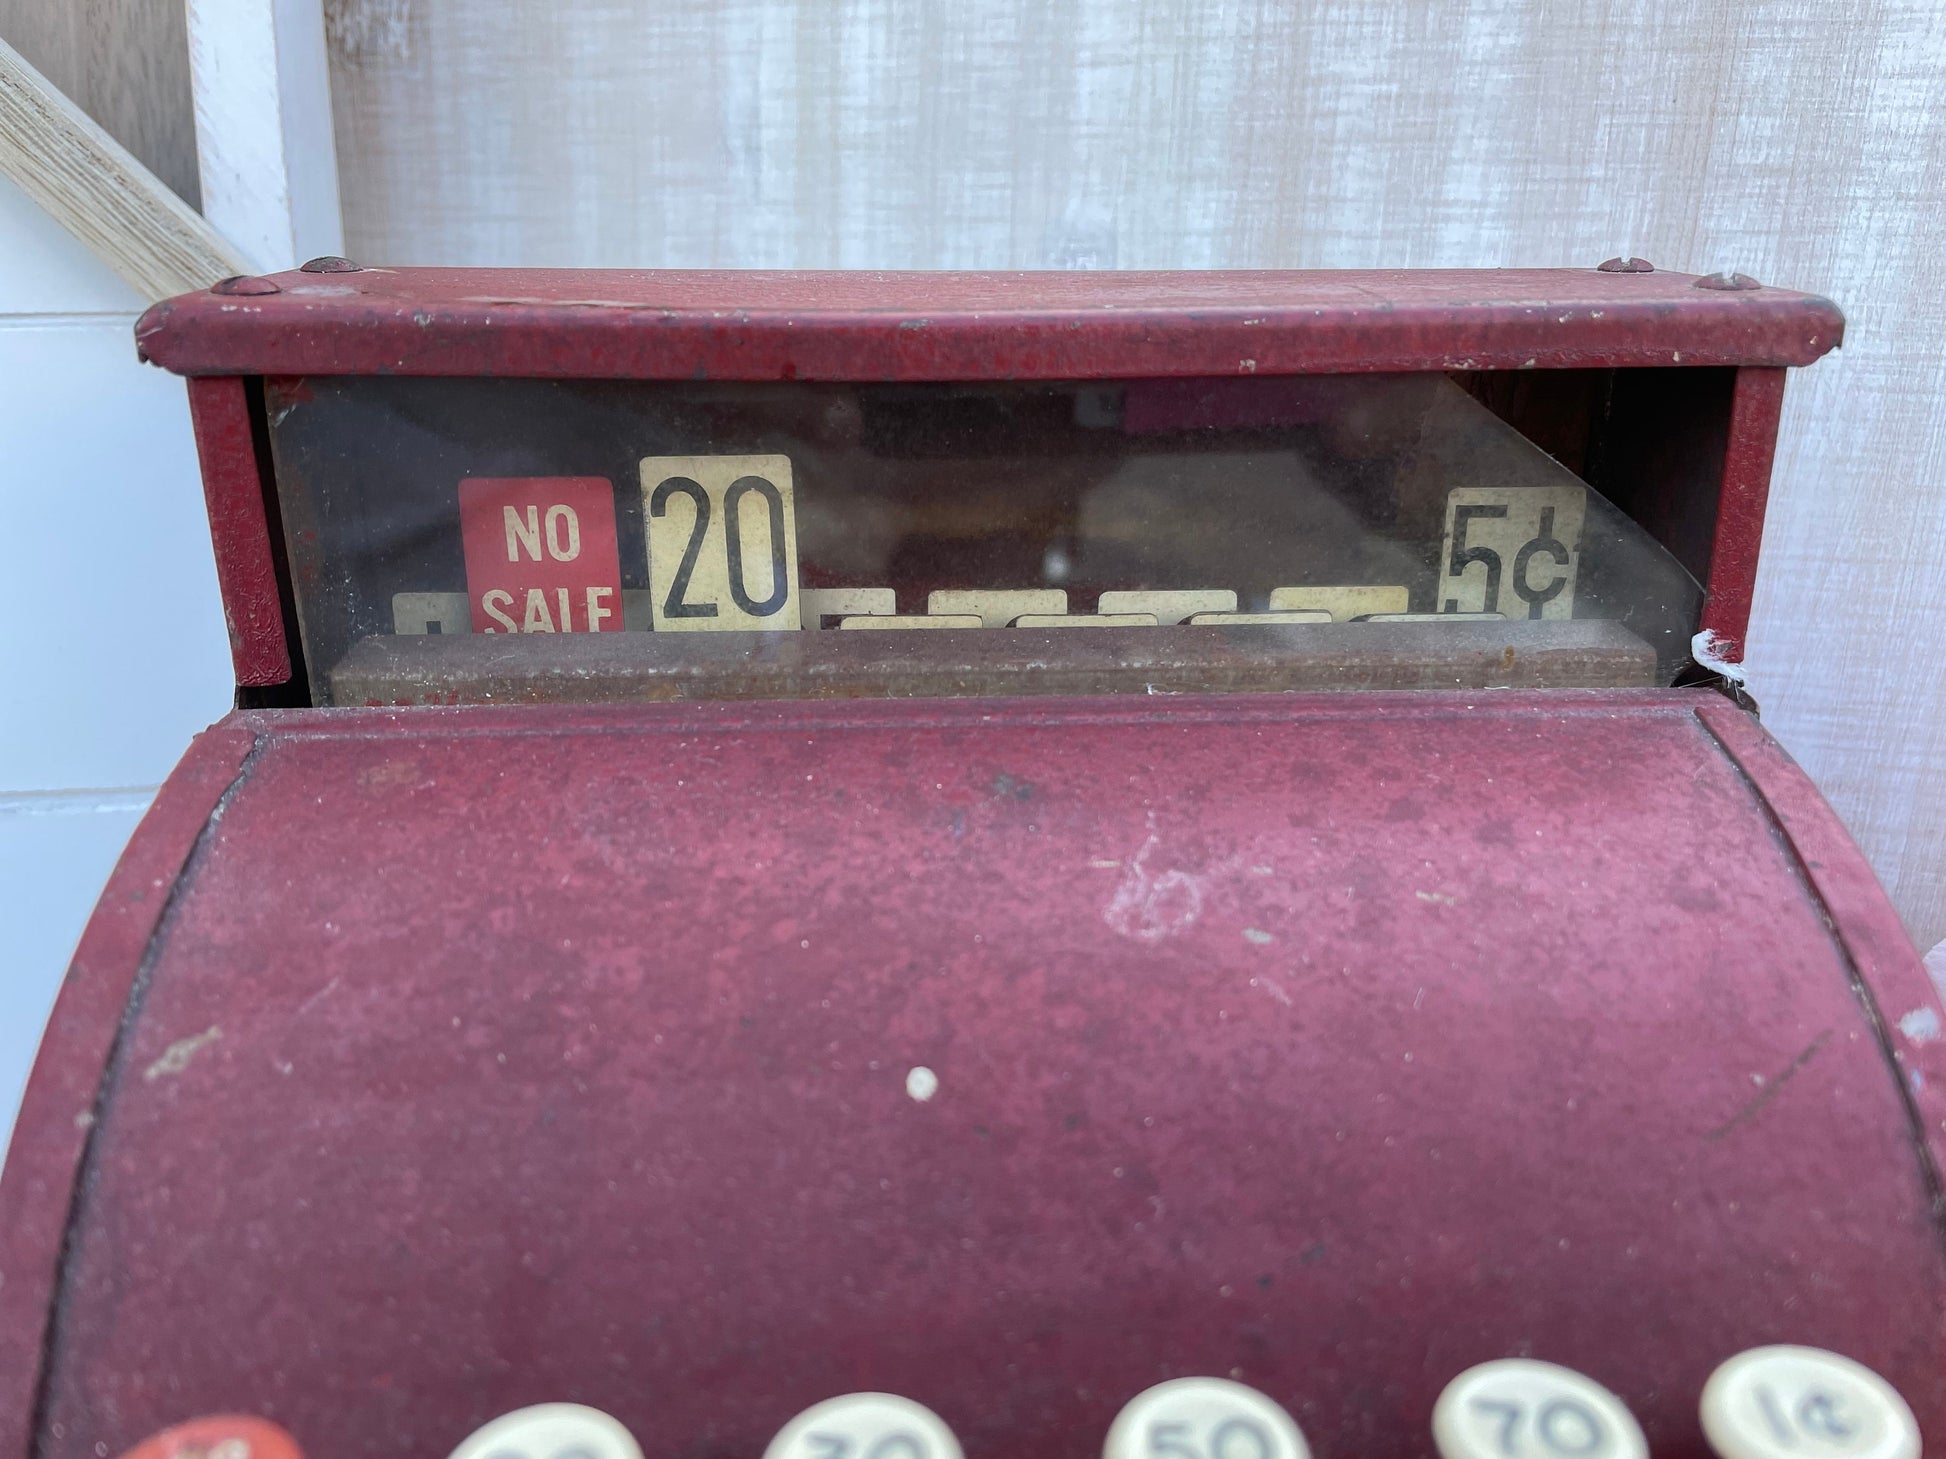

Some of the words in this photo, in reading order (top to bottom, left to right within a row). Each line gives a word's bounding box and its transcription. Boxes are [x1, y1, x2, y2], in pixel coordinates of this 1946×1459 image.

[504, 505, 580, 562] NO
[651, 477, 789, 617] 20
[1471, 1397, 1605, 1456] 70
